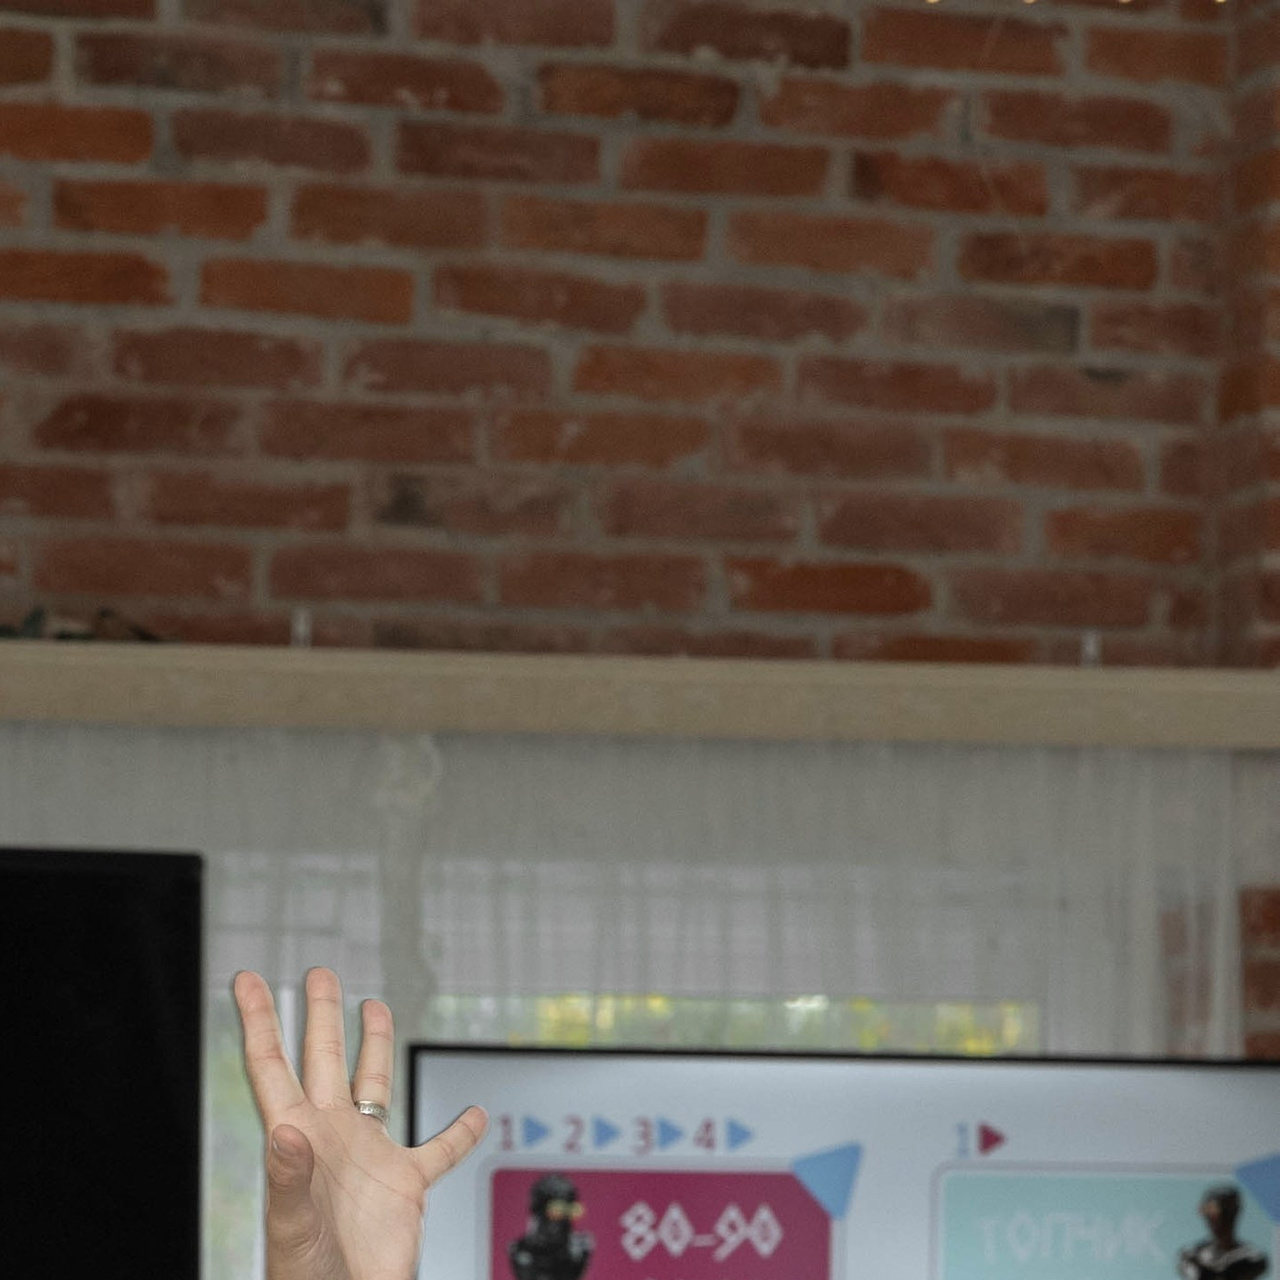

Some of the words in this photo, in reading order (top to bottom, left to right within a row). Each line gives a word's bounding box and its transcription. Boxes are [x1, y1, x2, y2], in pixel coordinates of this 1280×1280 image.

[565, 1115, 584, 1152] 2
[634, 1117, 653, 1155] 3
[693, 1117, 716, 1151] 4
[620, 1201, 784, 1263] 80-90
